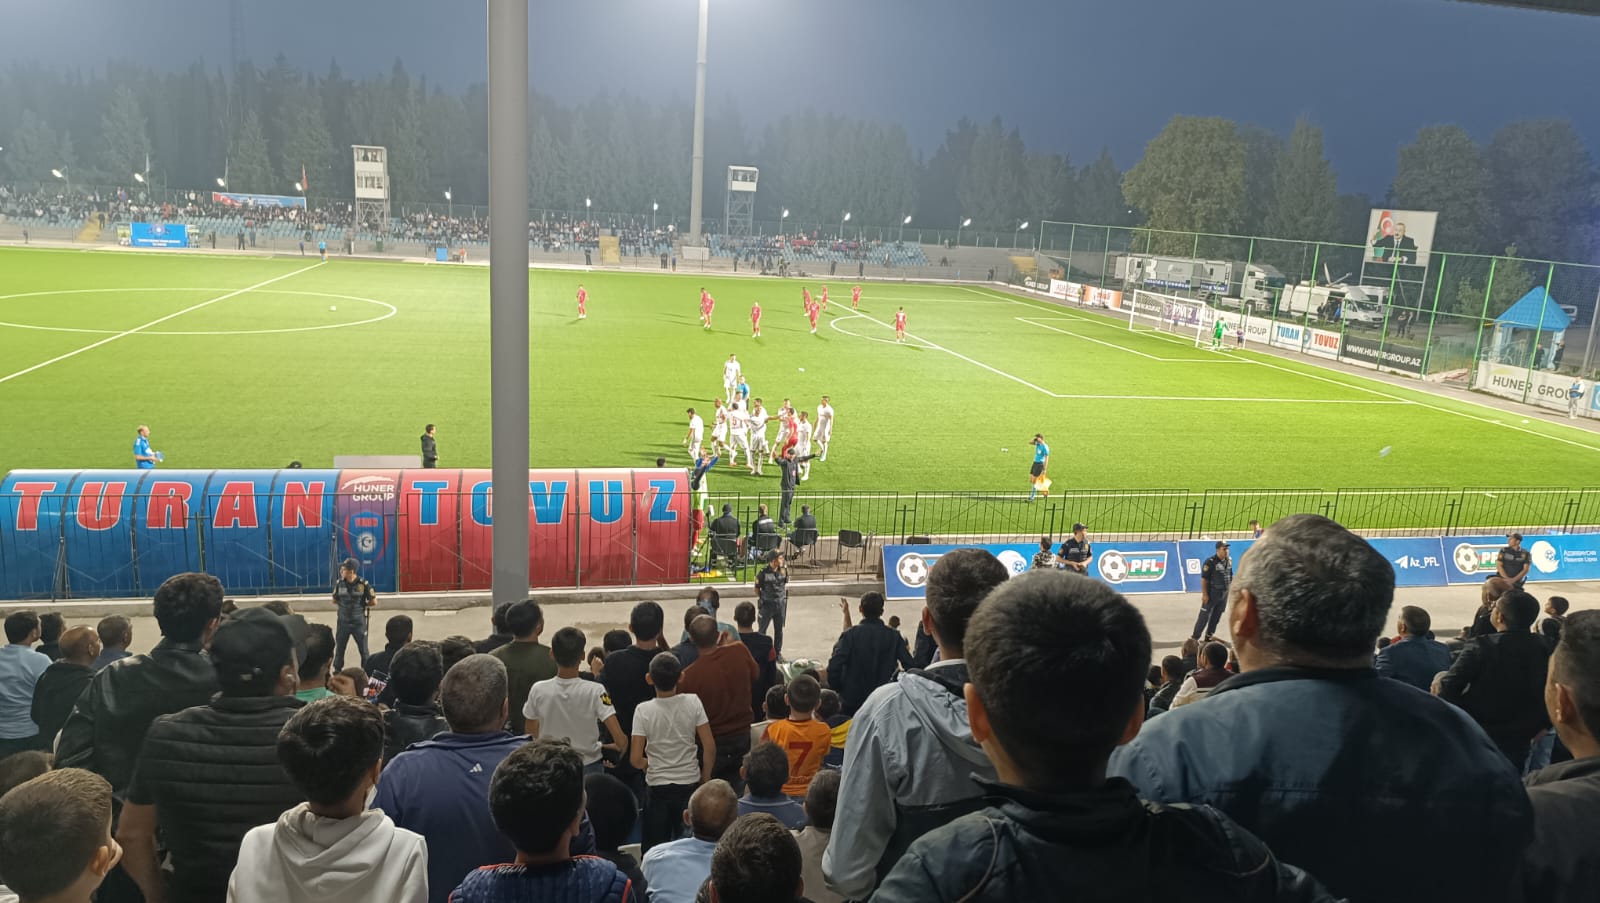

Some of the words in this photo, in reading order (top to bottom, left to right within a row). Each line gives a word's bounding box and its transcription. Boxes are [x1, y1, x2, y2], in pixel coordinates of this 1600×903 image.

[1277, 325, 1299, 340] TURAN
[1314, 333, 1339, 349] TOVUZ
[1537, 384, 1571, 401] GROU
[353, 484, 395, 492] HUNER
[352, 493, 395, 502] GROUP
[12, 481, 326, 531] TURAN
[1409, 556, 1440, 569] Az_PFL
[1481, 551, 1500, 565] PF
[1130, 559, 1160, 573] PFL
[789, 741, 813, 777] 7
